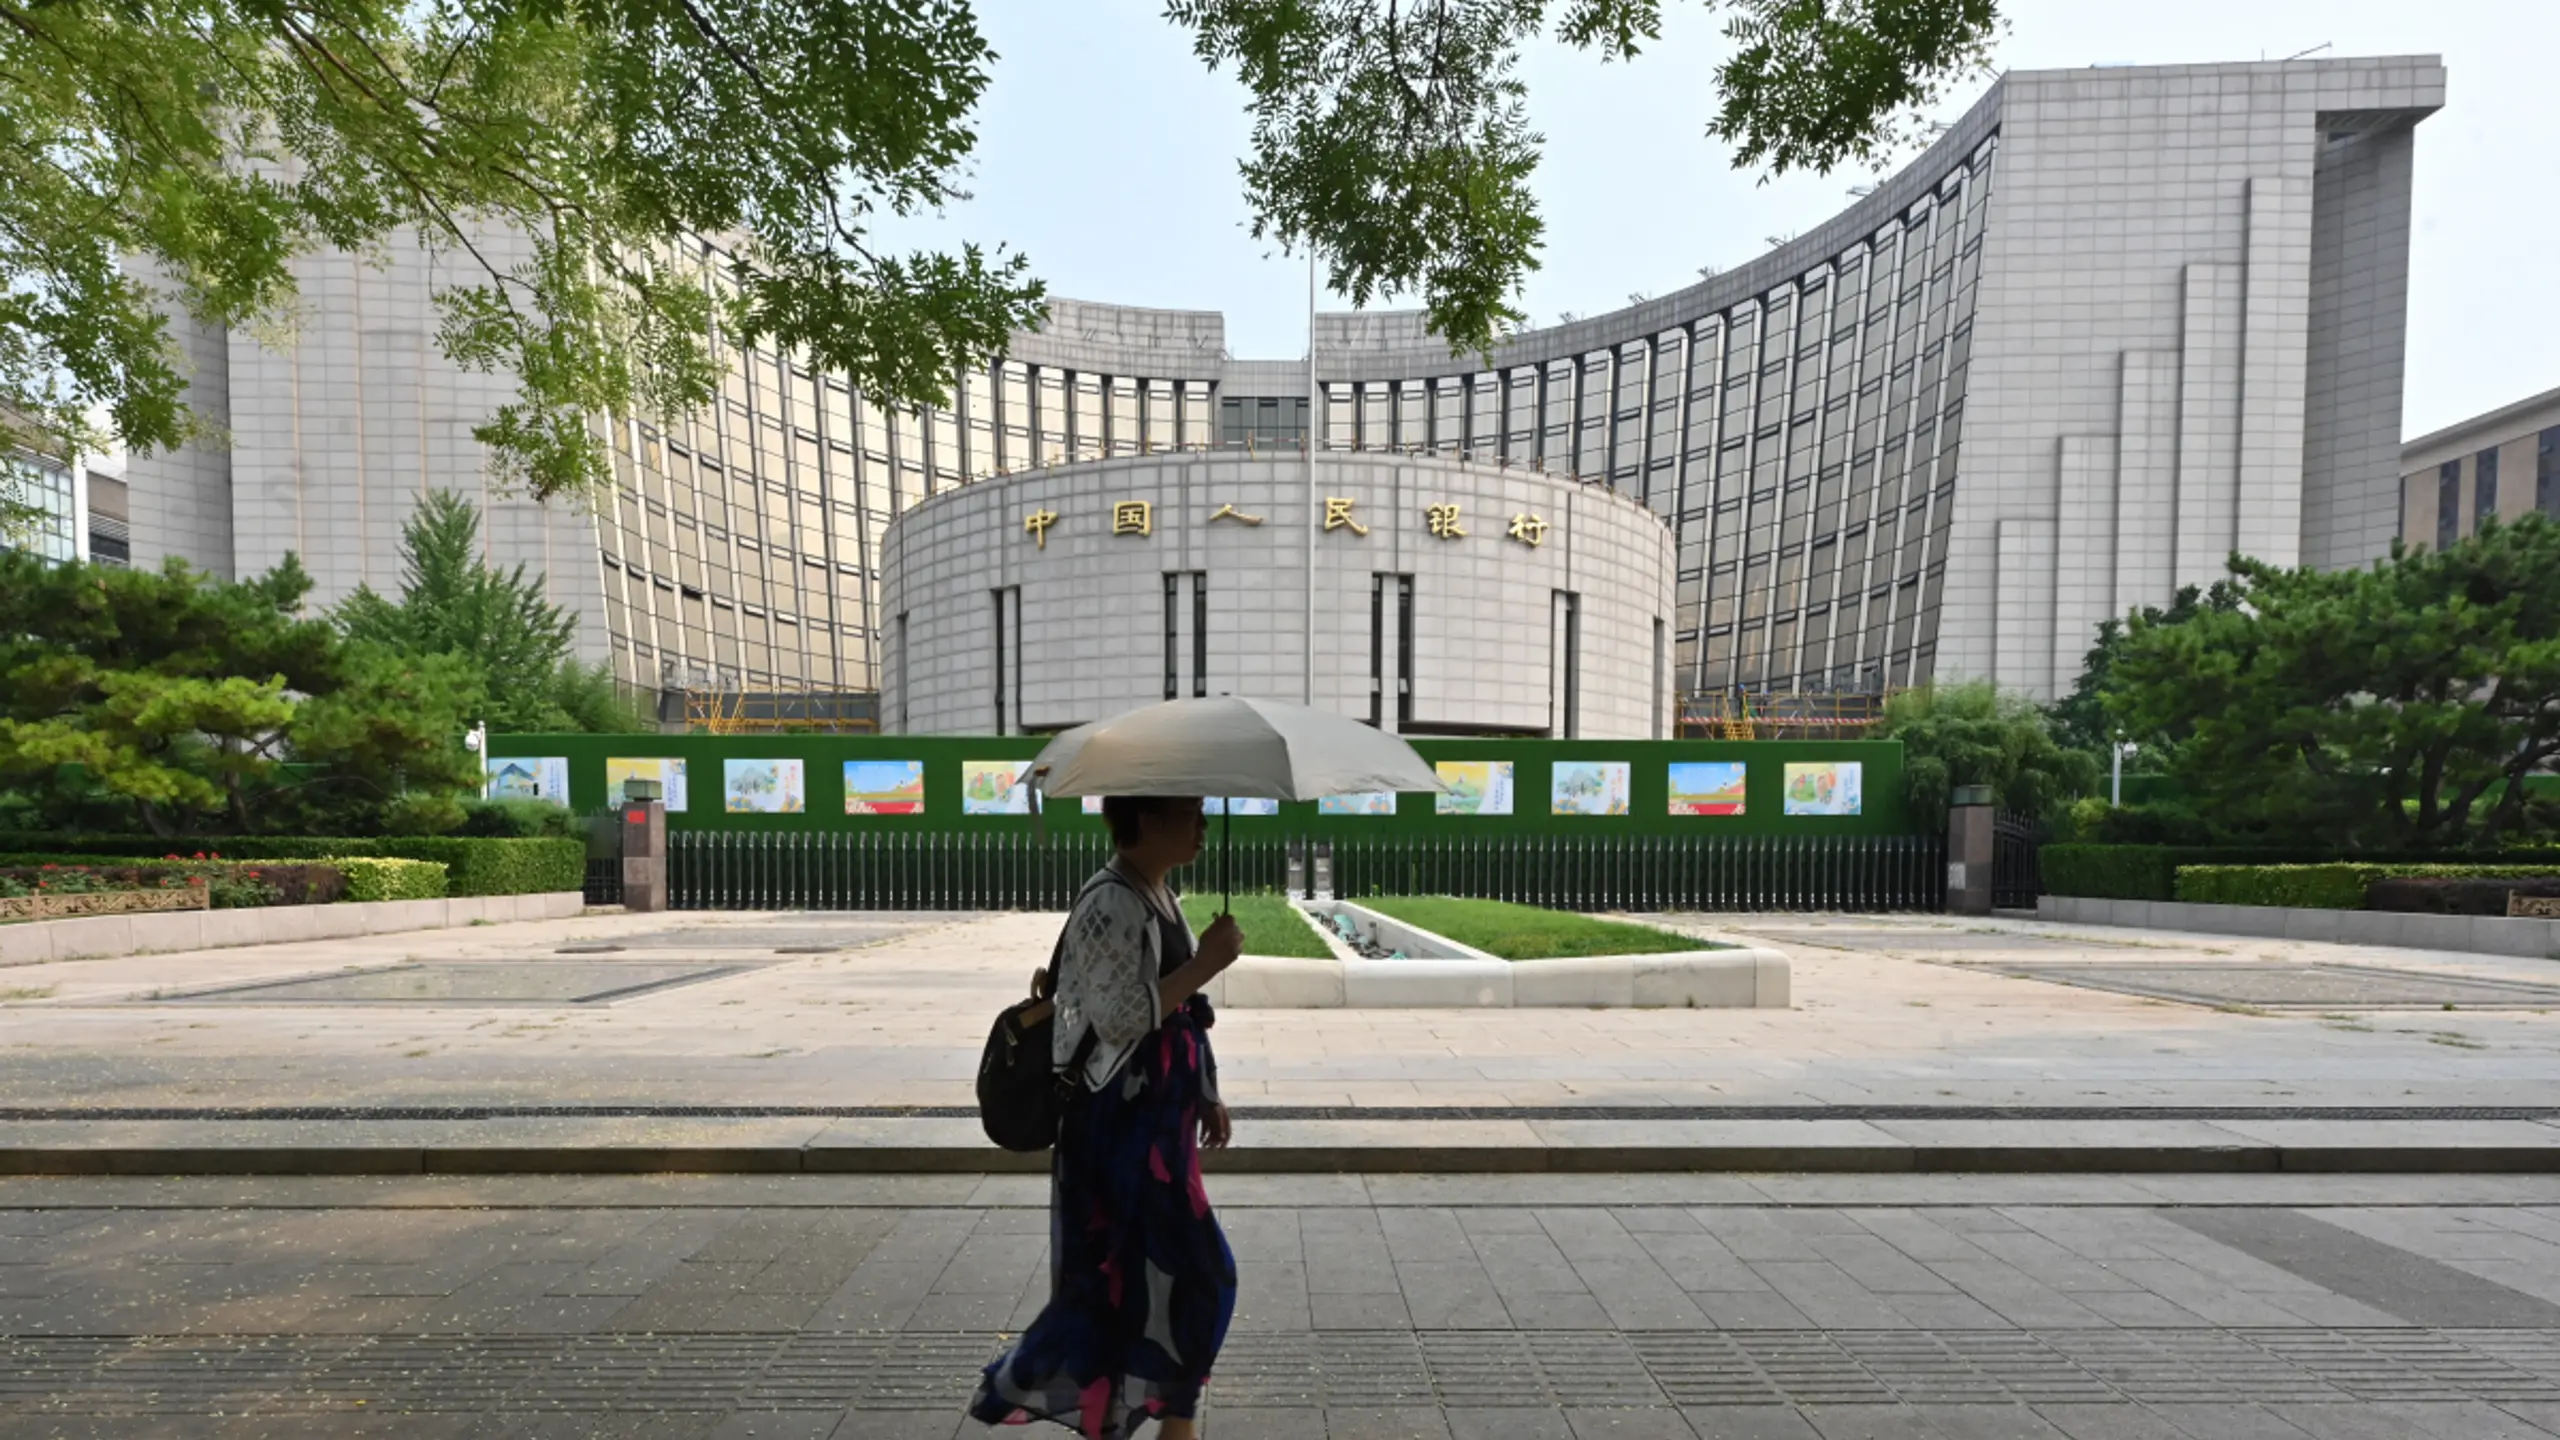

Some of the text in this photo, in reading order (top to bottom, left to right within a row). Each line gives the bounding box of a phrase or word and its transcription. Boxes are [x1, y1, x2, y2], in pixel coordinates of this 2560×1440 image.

[1023, 496, 1549, 550] 中国人民银行
